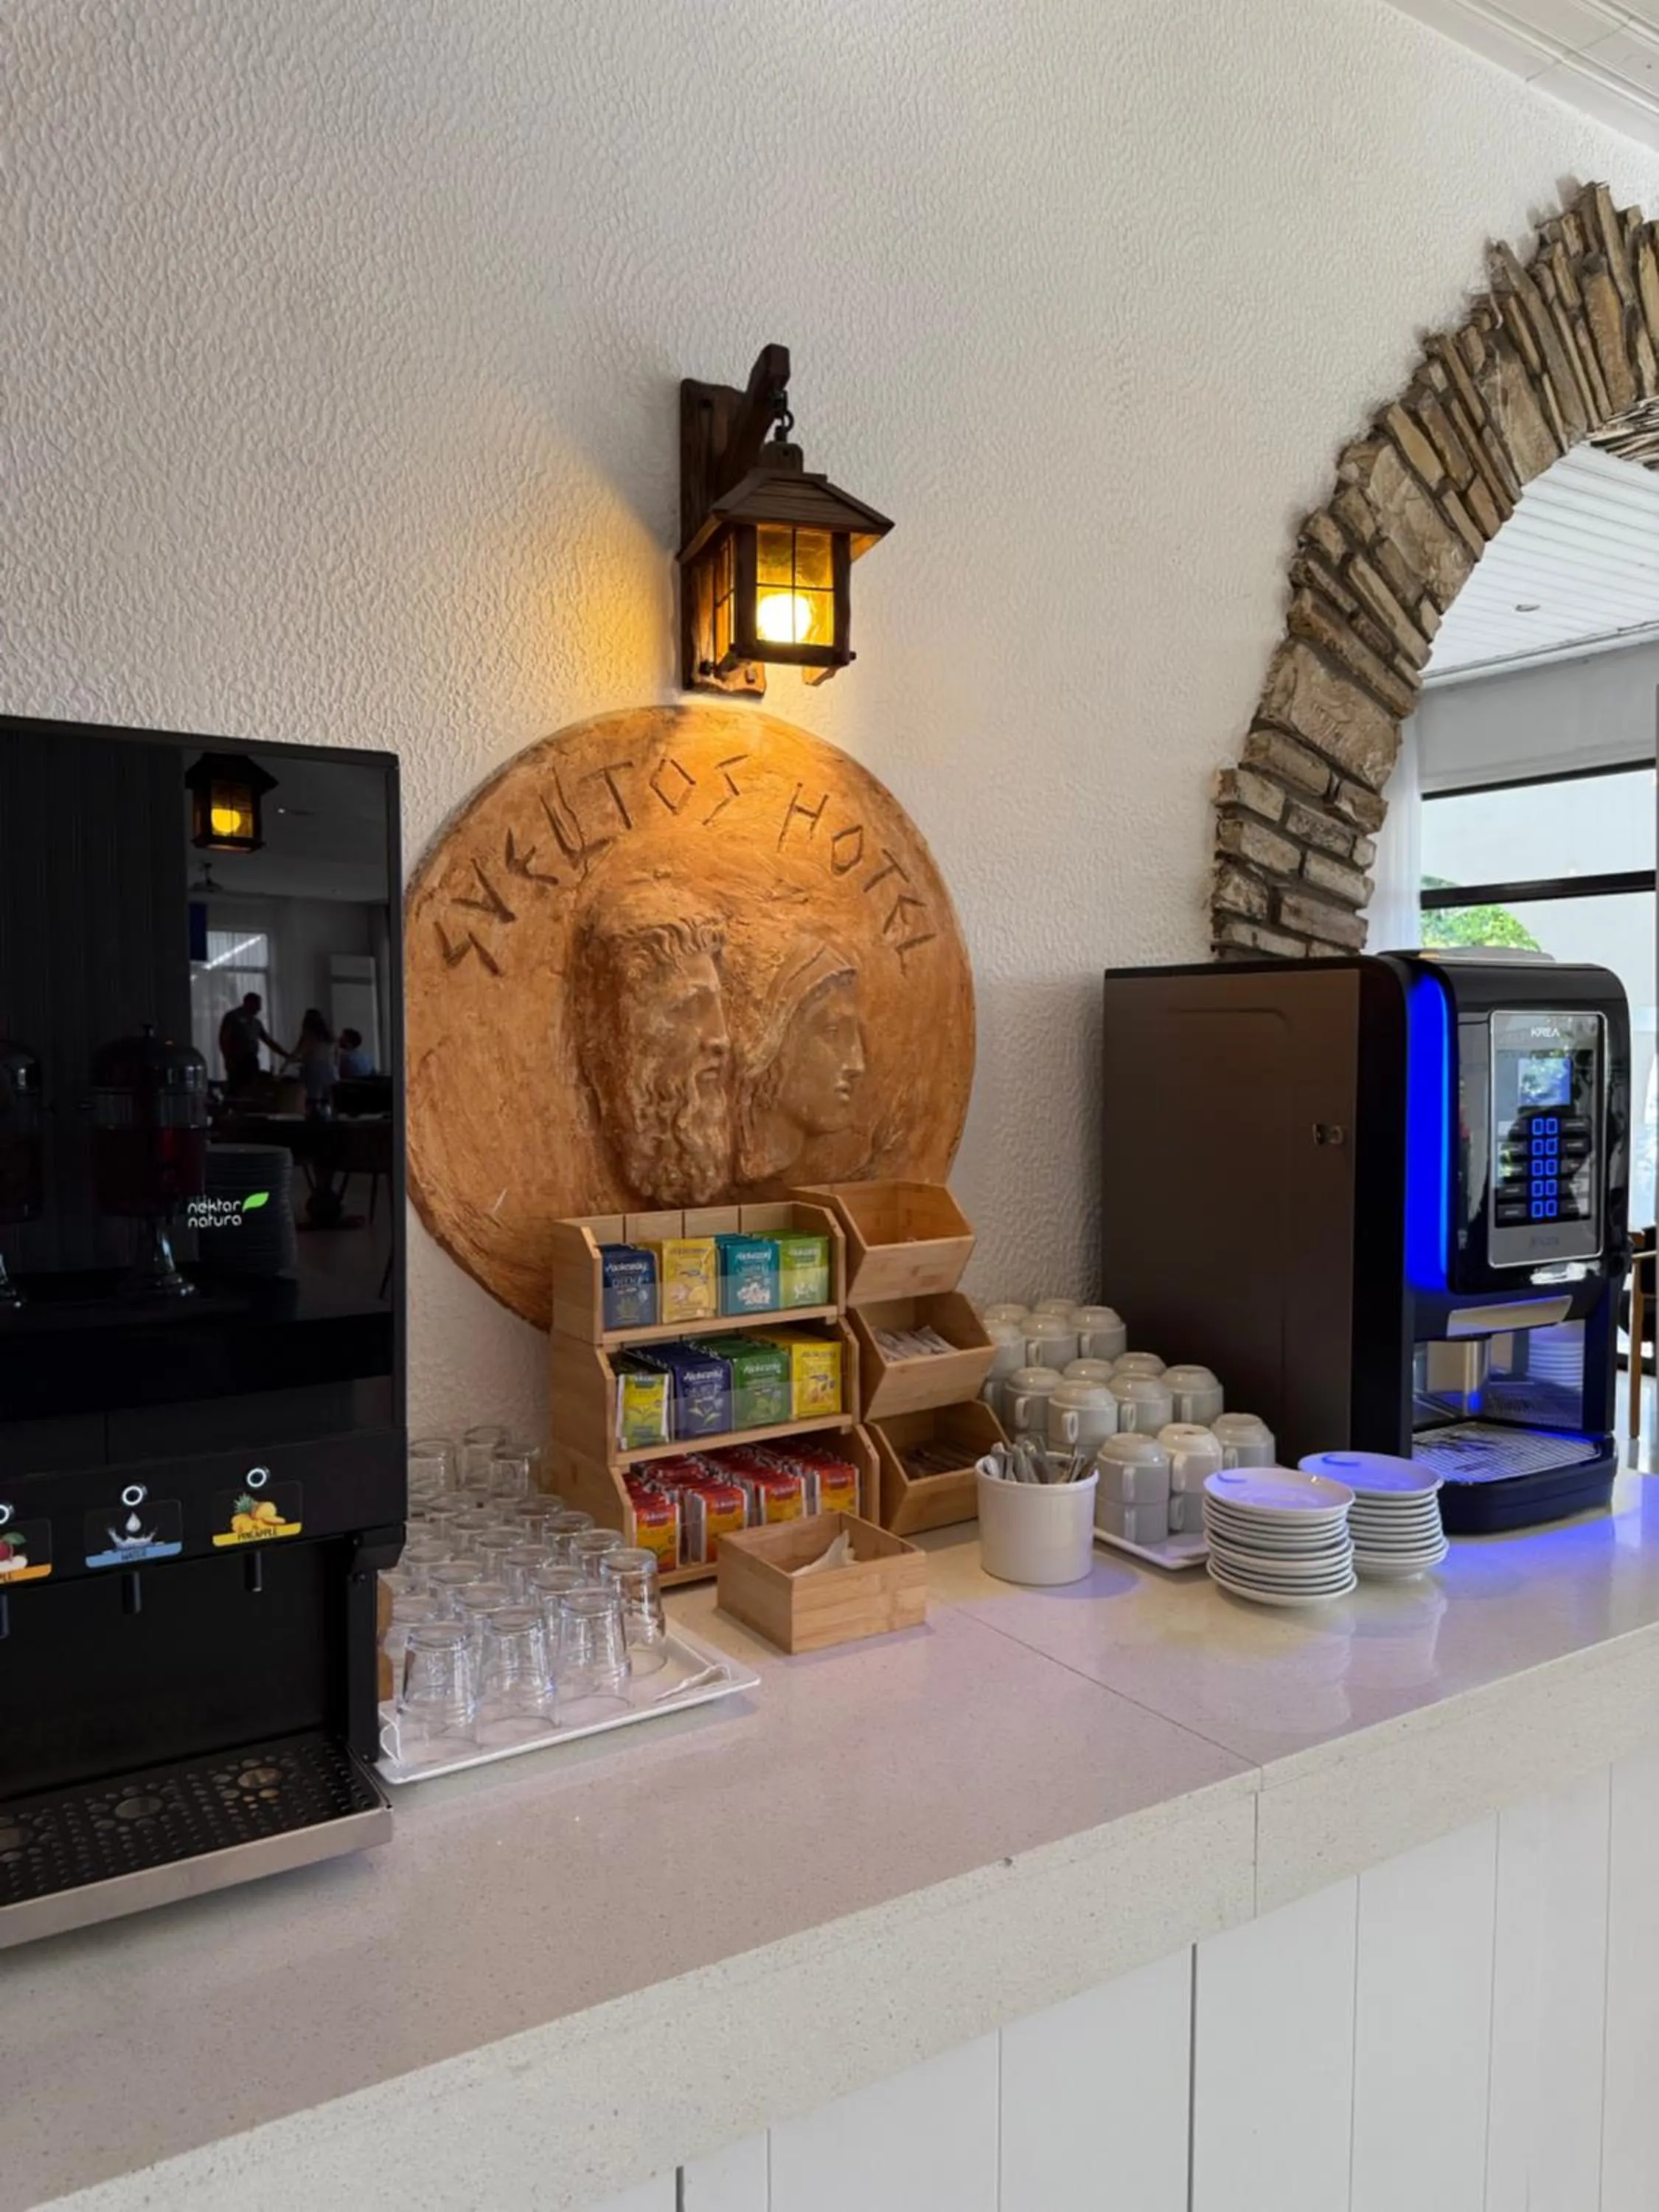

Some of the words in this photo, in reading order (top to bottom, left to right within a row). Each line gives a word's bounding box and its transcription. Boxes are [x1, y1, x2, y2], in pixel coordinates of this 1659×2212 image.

[776, 781, 938, 978] HOTEL
[187, 1197, 242, 1214] nektar
[188, 1214, 243, 1228] natura
